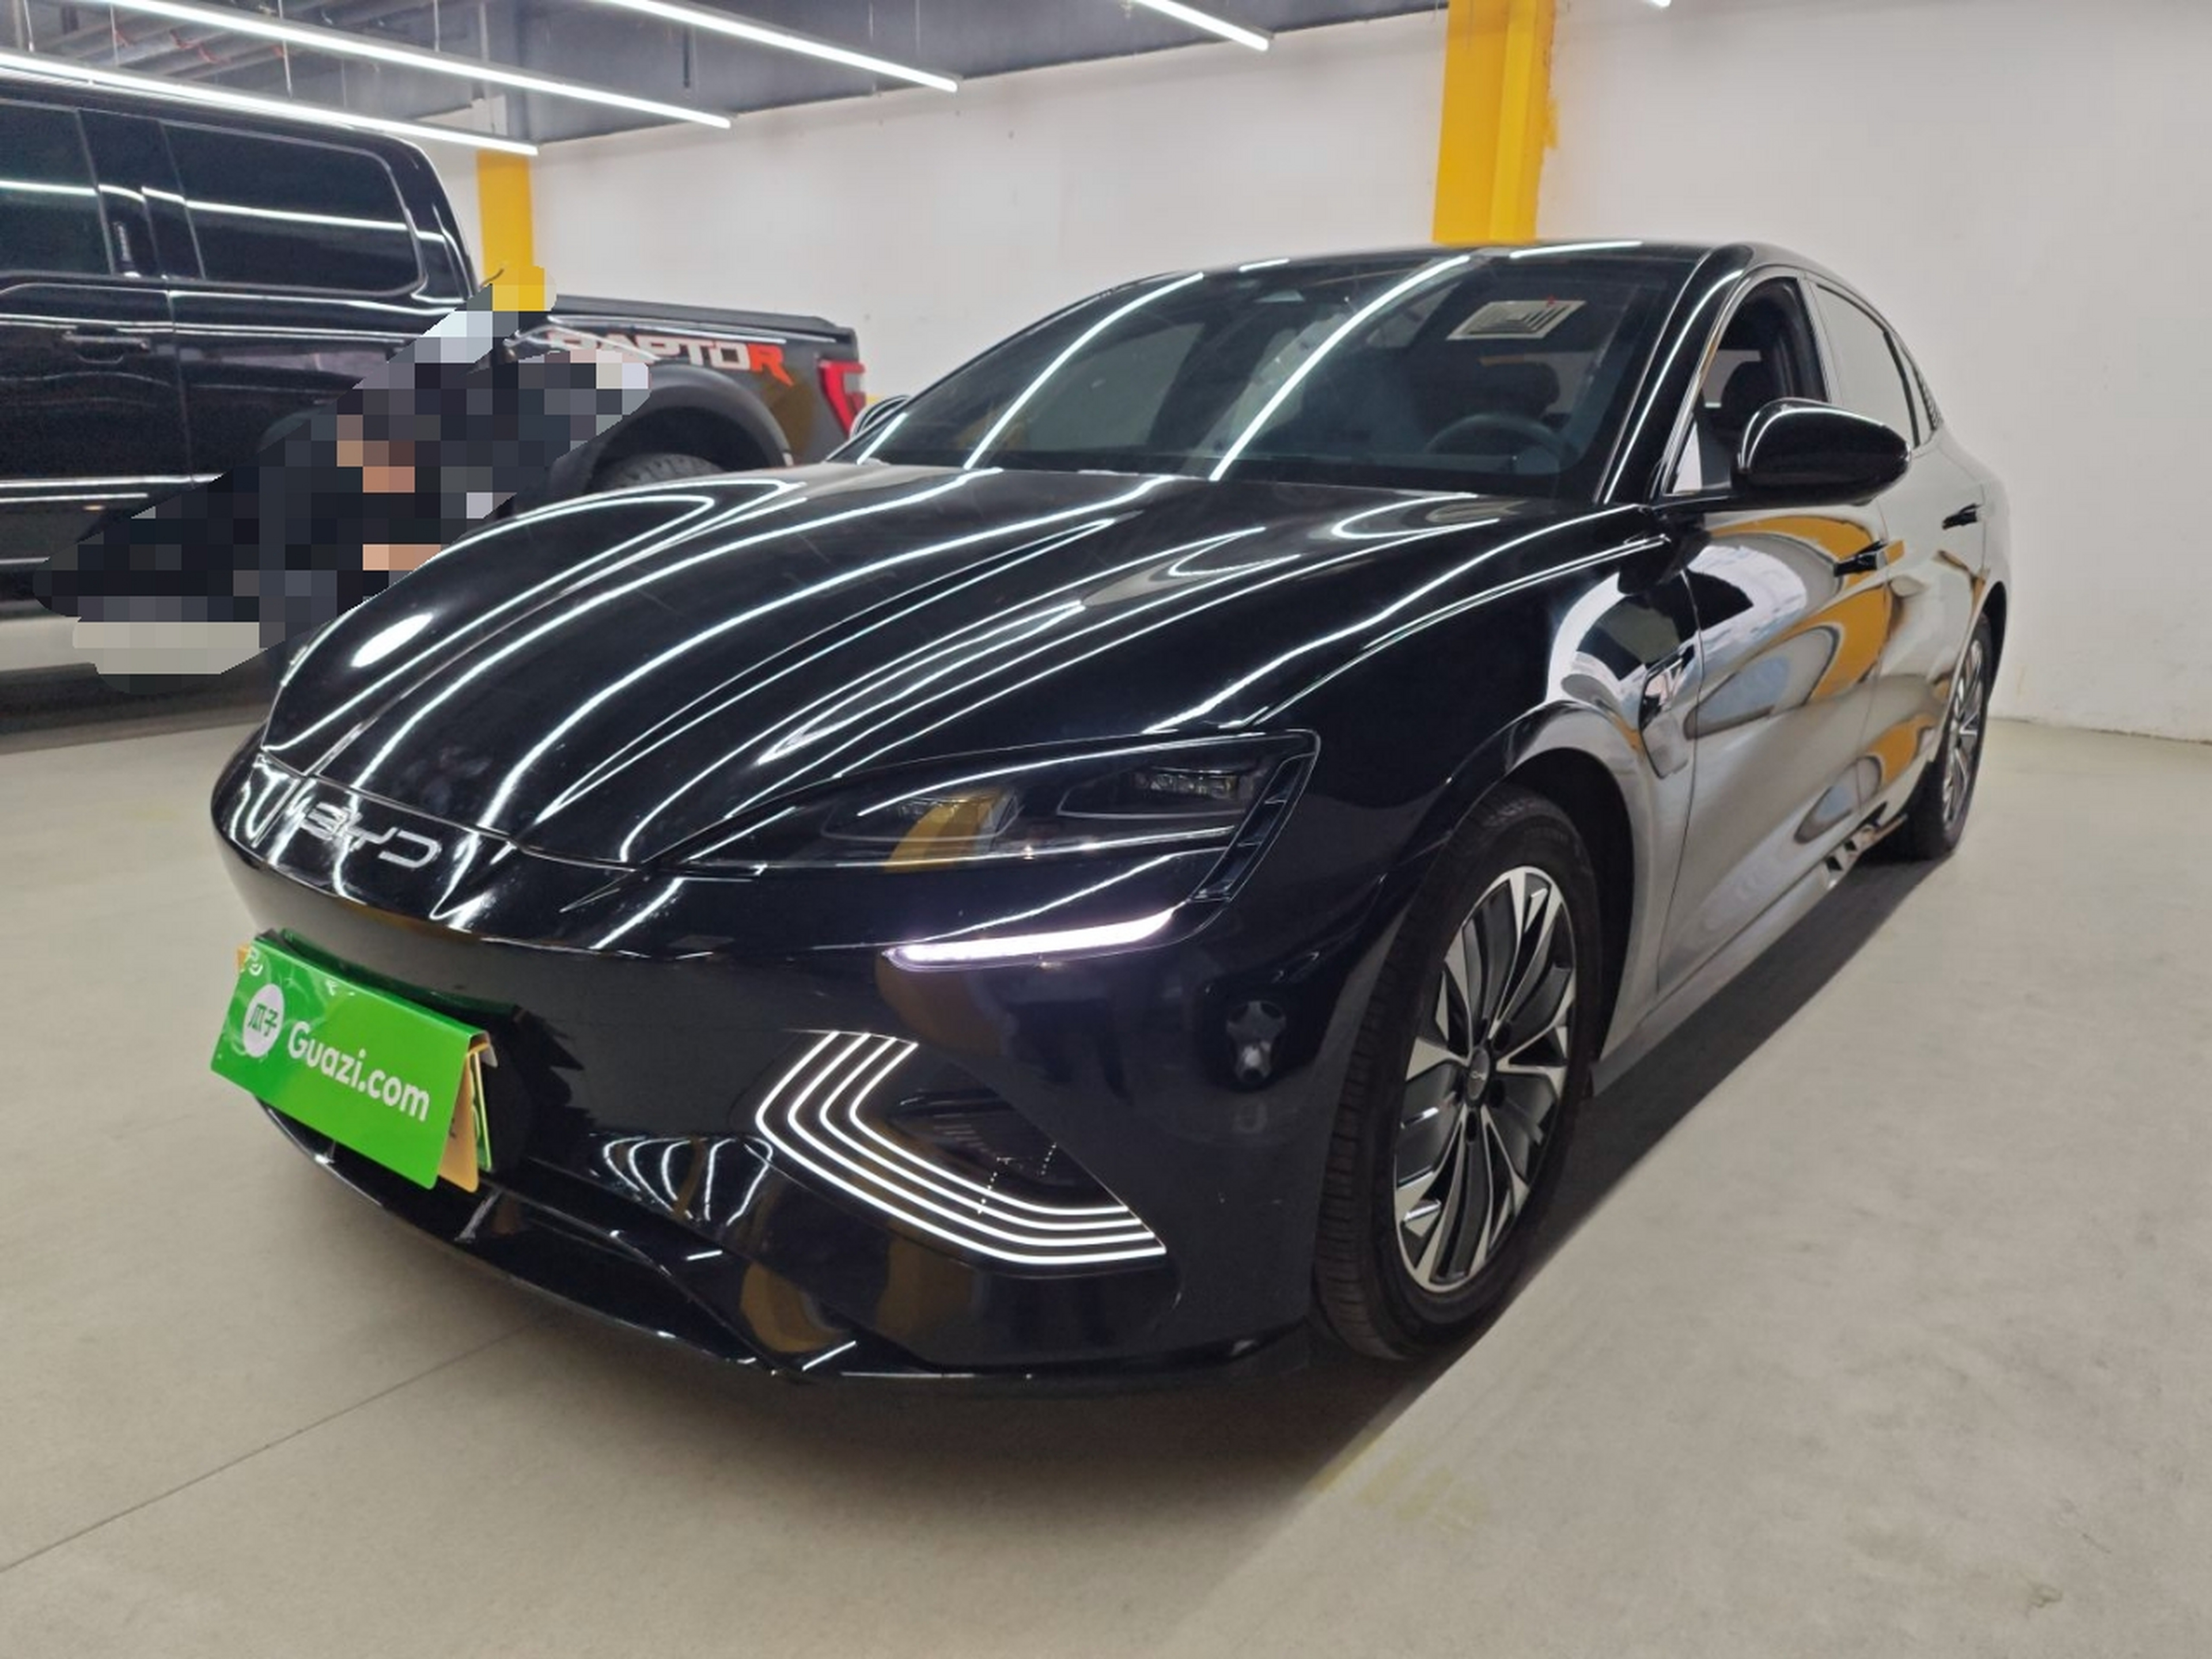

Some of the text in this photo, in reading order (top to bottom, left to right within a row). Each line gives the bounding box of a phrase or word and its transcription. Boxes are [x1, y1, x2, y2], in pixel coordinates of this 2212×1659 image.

[299, 802, 442, 868] BYD
[248, 1003, 279, 1037] 瓜子
[288, 1021, 430, 1122] Guazi.com
